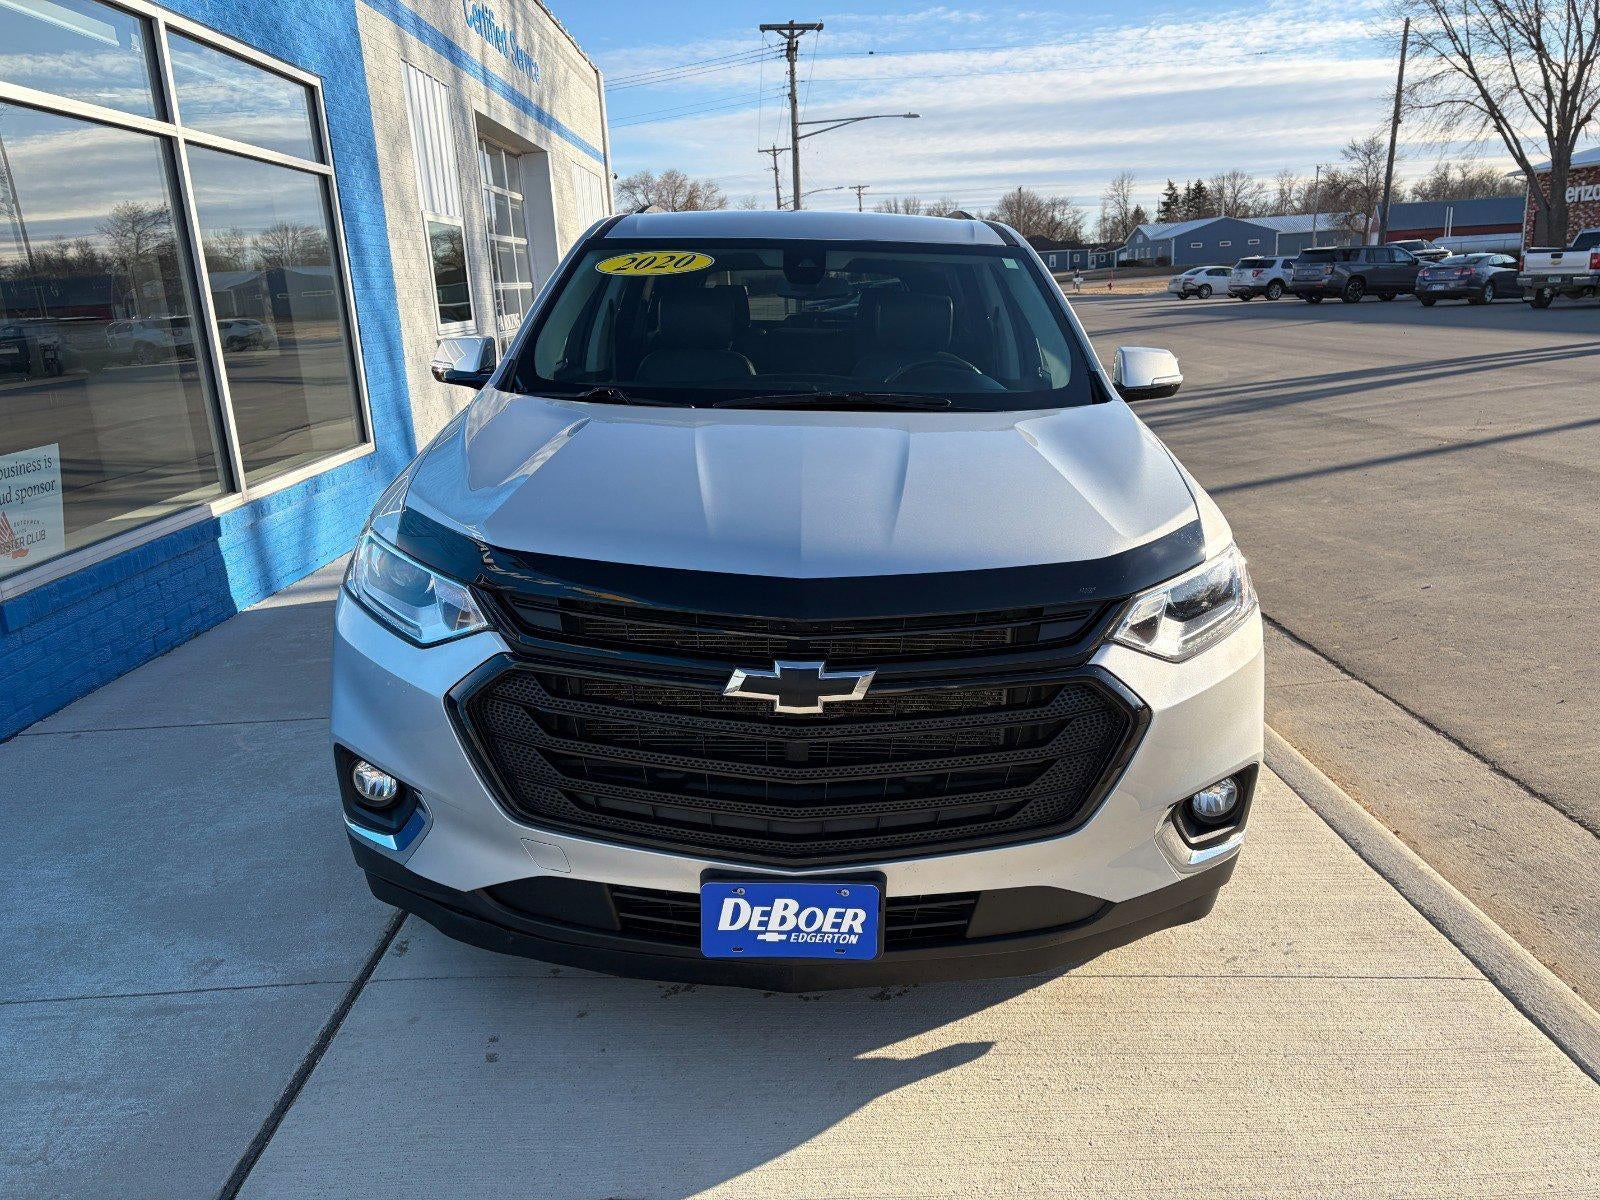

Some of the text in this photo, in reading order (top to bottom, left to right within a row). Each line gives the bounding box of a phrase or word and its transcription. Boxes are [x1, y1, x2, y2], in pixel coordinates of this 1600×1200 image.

[510, 31, 541, 85] Service
[1565, 181, 1600, 204] erizo
[613, 255, 697, 271] 2020
[43, 455, 53, 469] is
[0, 480, 56, 506] ud sponsor
[26, 529, 46, 545] CLUB
[789, 932, 859, 945] EDGERTON
